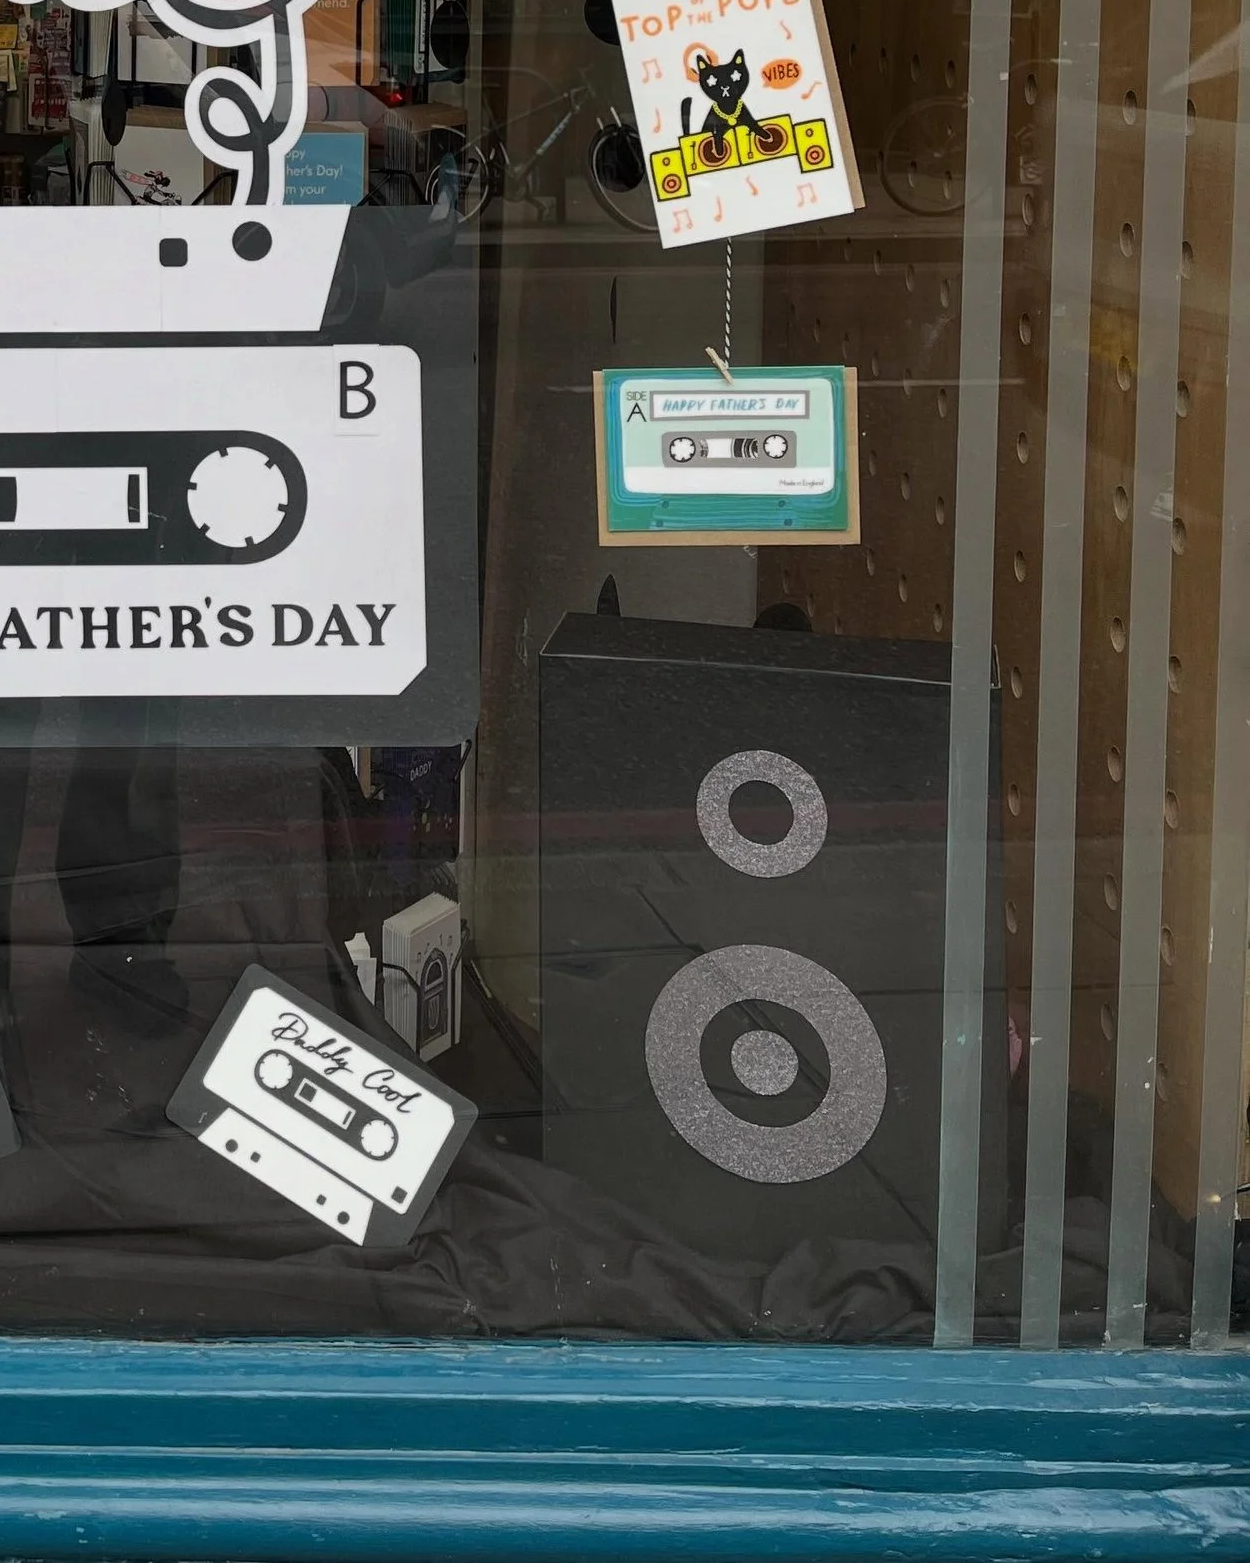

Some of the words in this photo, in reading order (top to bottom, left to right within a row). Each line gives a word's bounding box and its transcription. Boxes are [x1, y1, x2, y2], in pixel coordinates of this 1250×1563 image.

[621, 4, 683, 42] TOP
[686, 12, 714, 26] THE
[762, 63, 799, 82] VIBES
[317, 164, 343, 180] Day!
[301, 186, 326, 197] your
[341, 361, 376, 419] B
[626, 391, 647, 401] SIDE
[627, 402, 647, 422] A
[662, 399, 705, 412] HAPPY
[775, 398, 800, 411] DAY
[272, 602, 397, 647] DAY
[271, 1012, 354, 1076] Daddy
[362, 1068, 422, 1113] Cool
